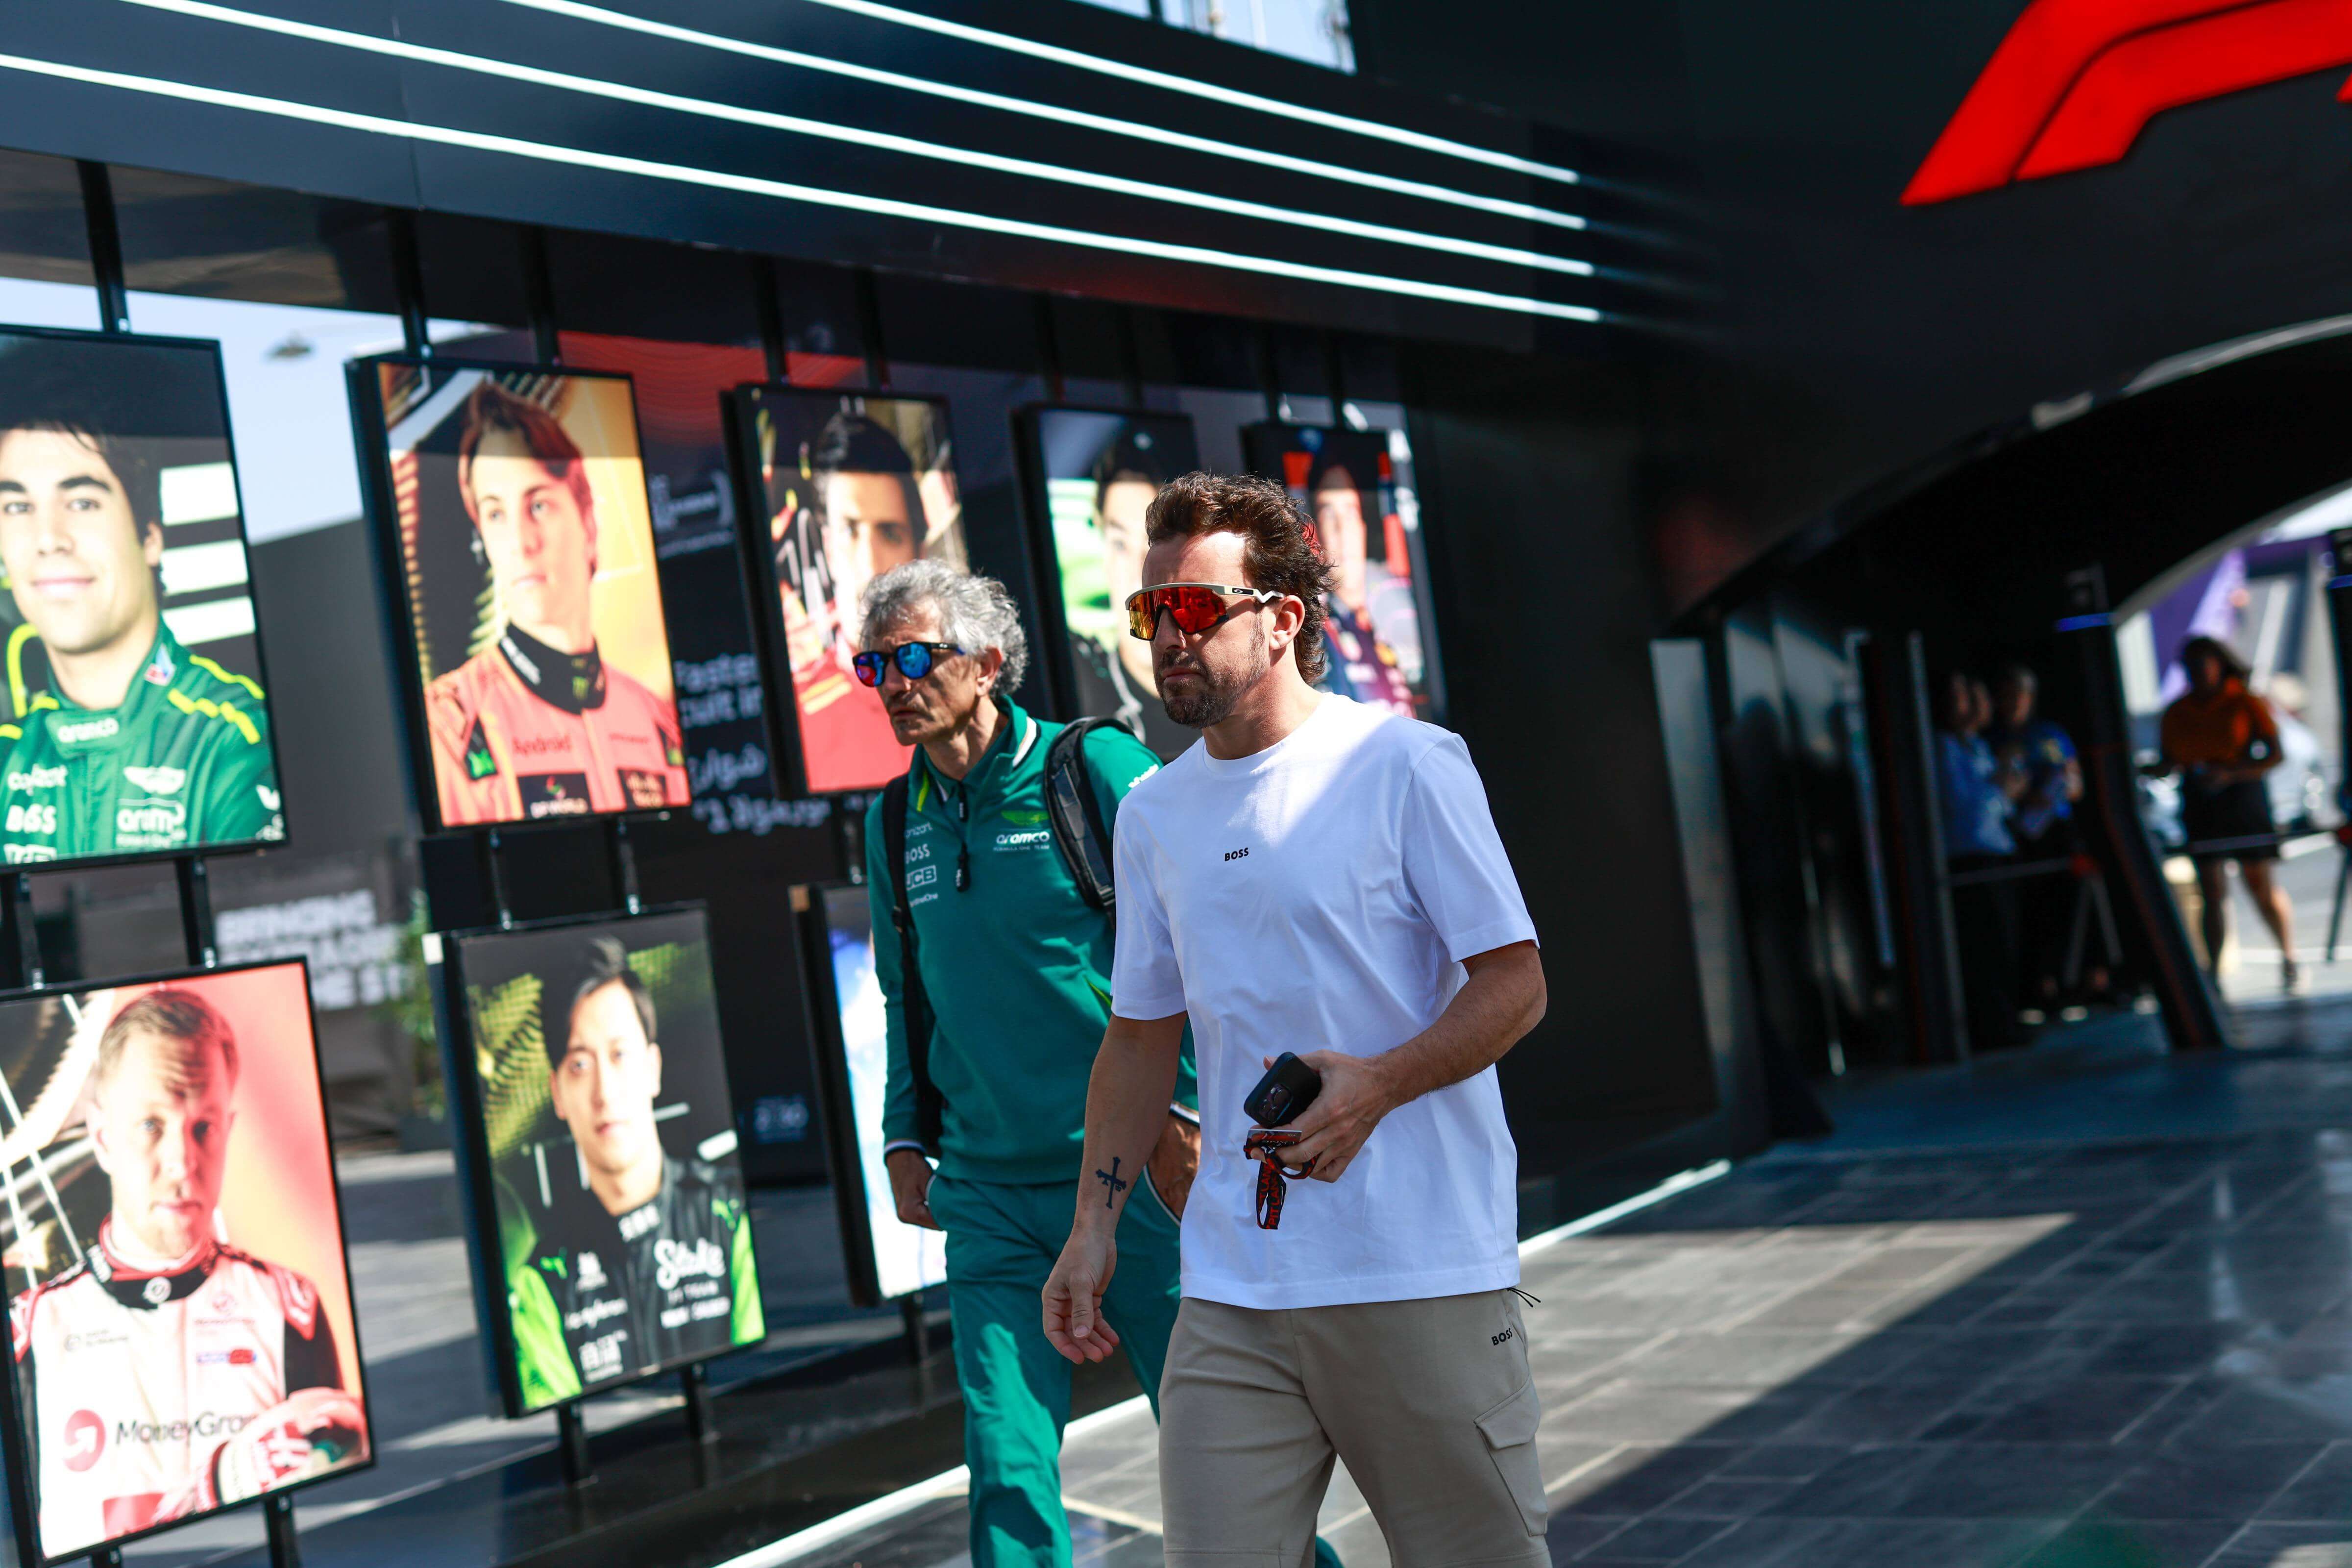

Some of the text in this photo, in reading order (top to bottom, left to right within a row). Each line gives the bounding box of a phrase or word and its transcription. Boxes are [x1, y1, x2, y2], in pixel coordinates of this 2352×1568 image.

[996, 831, 1050, 844] aramco
[1224, 847, 1250, 861] BOSS
[1268, 1207, 1279, 1225] PIT
[1491, 1327, 1513, 1346] BOSS
